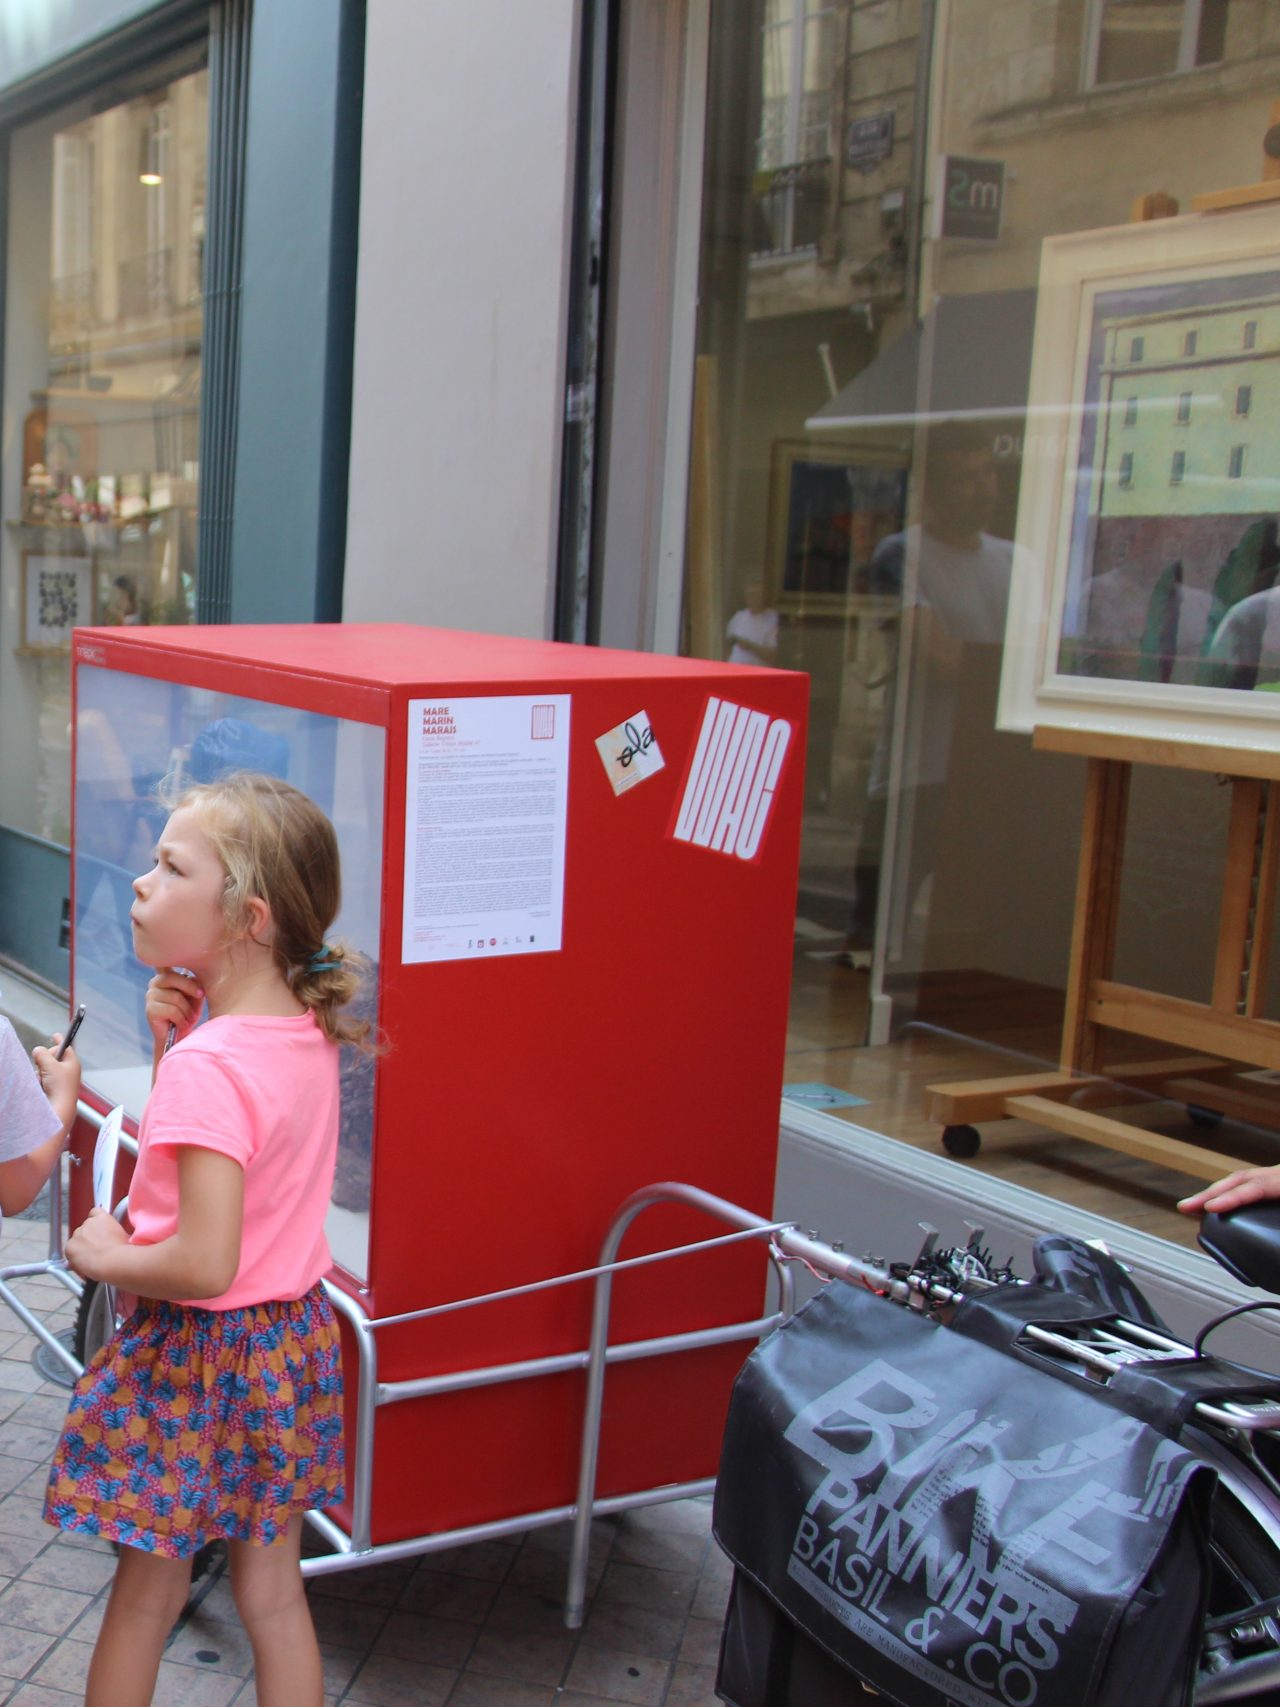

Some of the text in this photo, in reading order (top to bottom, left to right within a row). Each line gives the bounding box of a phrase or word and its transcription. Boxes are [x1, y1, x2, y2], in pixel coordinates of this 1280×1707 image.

[422, 725, 457, 735] MARAIS
[423, 707, 449, 716] MARE
[423, 716, 454, 726] MARIN
[783, 1358, 1150, 1626] BIKE
[793, 1516, 891, 1623] BASIL
[905, 1606, 945, 1653] &
[806, 1470, 1070, 1670] PANNIERS
